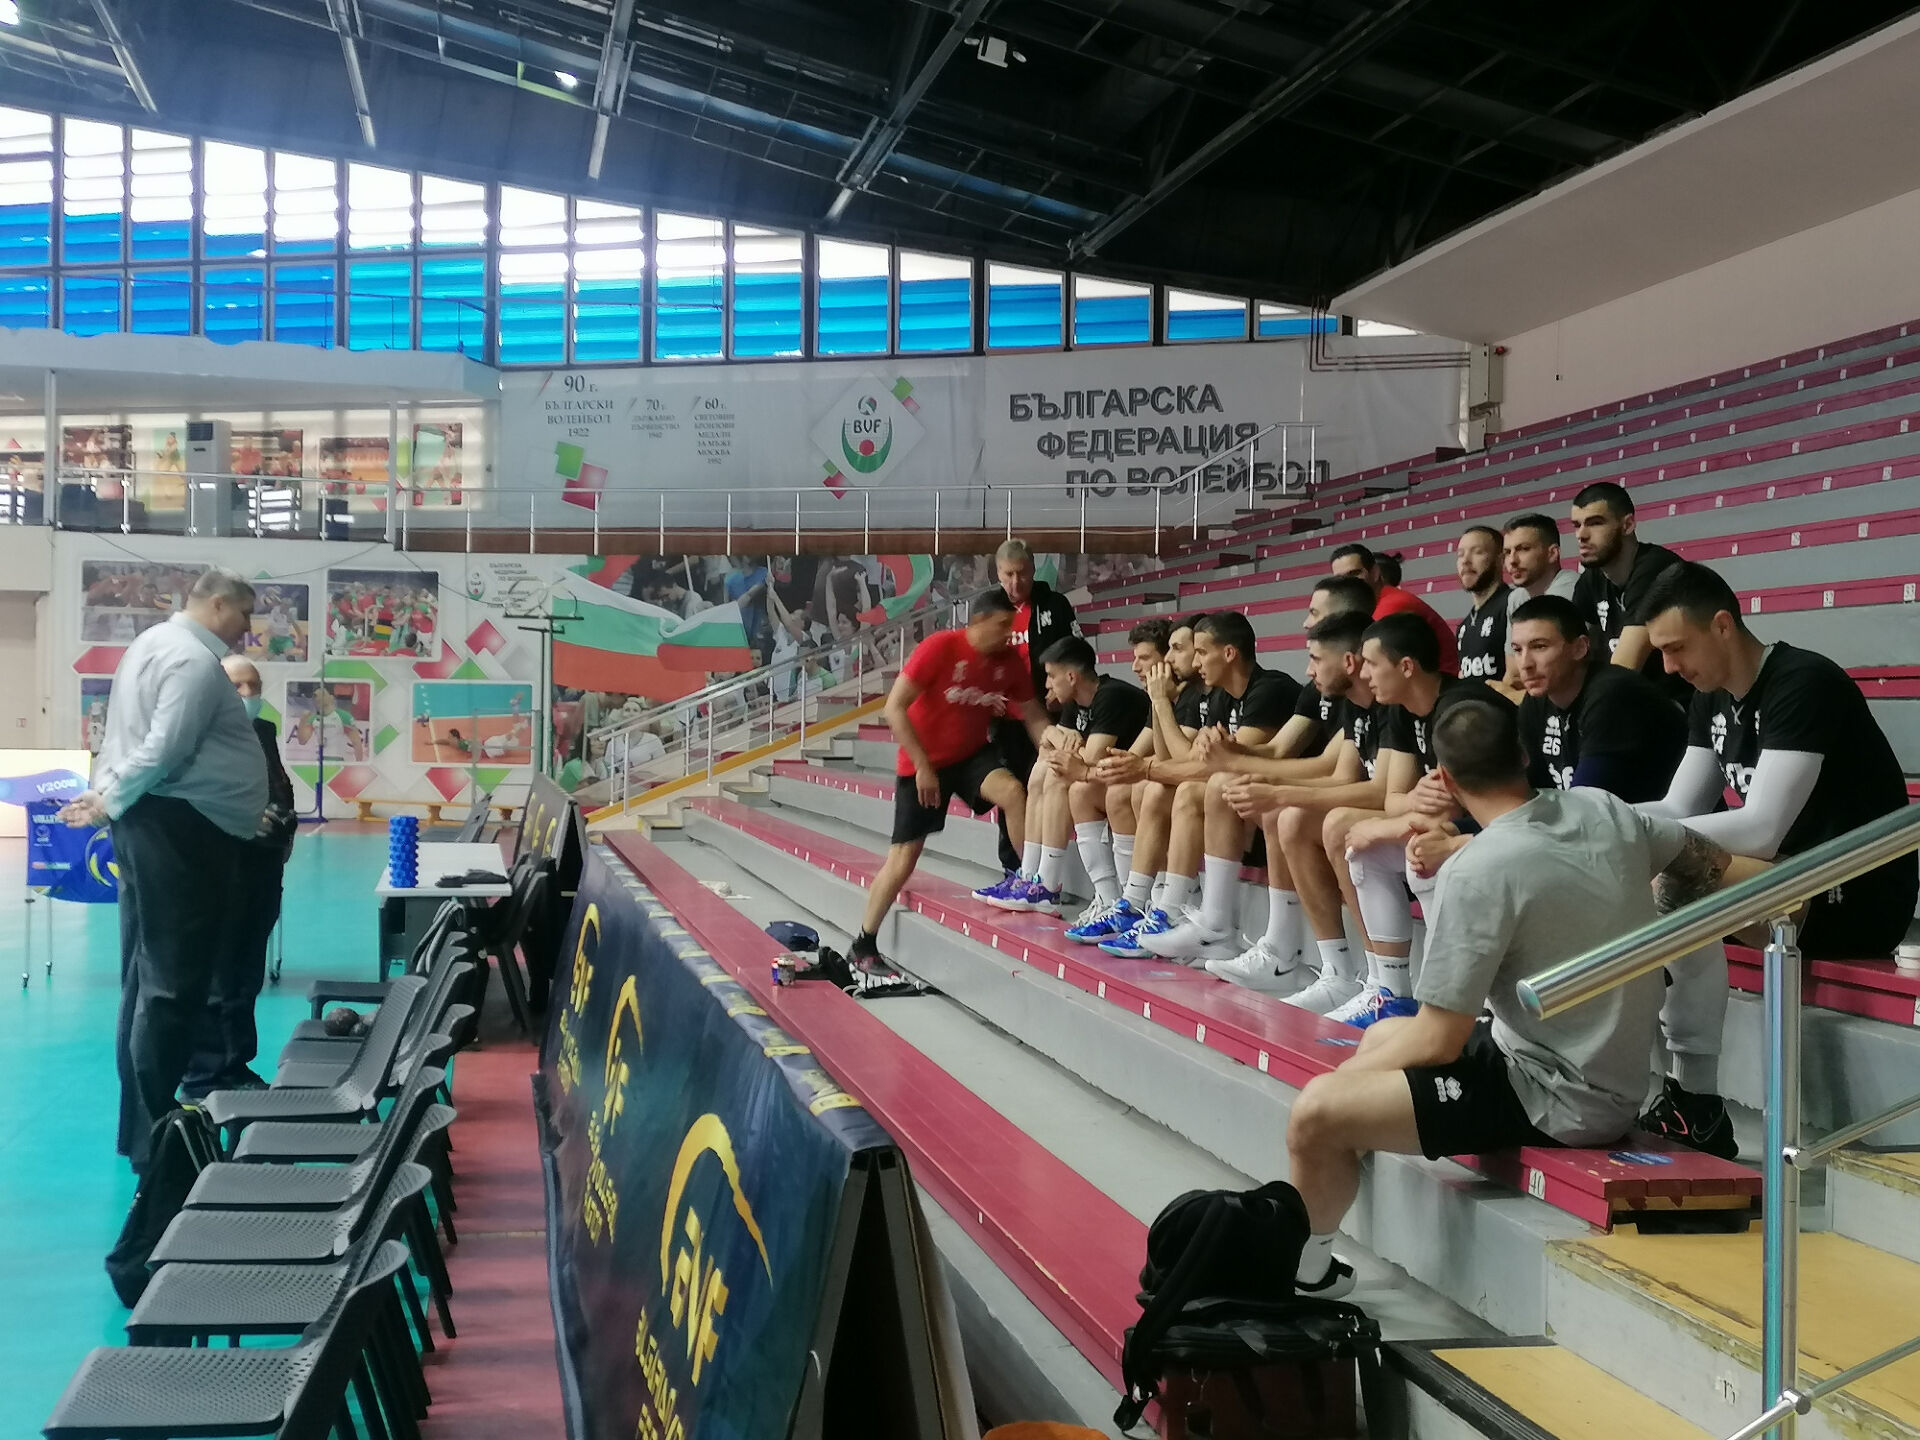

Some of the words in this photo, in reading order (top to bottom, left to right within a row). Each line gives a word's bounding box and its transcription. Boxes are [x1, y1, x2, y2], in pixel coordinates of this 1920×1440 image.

[564, 375, 585, 393] 90
[545, 400, 613, 410] БЪЛГАРСКИ
[705, 398, 719, 410] 60
[1009, 384, 1224, 422] БЪЛГАРСКА
[547, 414, 611, 425] ВОЛЕЙБОЛ
[853, 418, 881, 434] BVF
[568, 428, 589, 438] 1922
[1036, 422, 1259, 463] ФЕДЕРАЦИЯ
[1065, 467, 1118, 498] ПО
[1126, 457, 1330, 495] ВОЛЕЙБОЛ
[1543, 737, 1562, 756] 26
